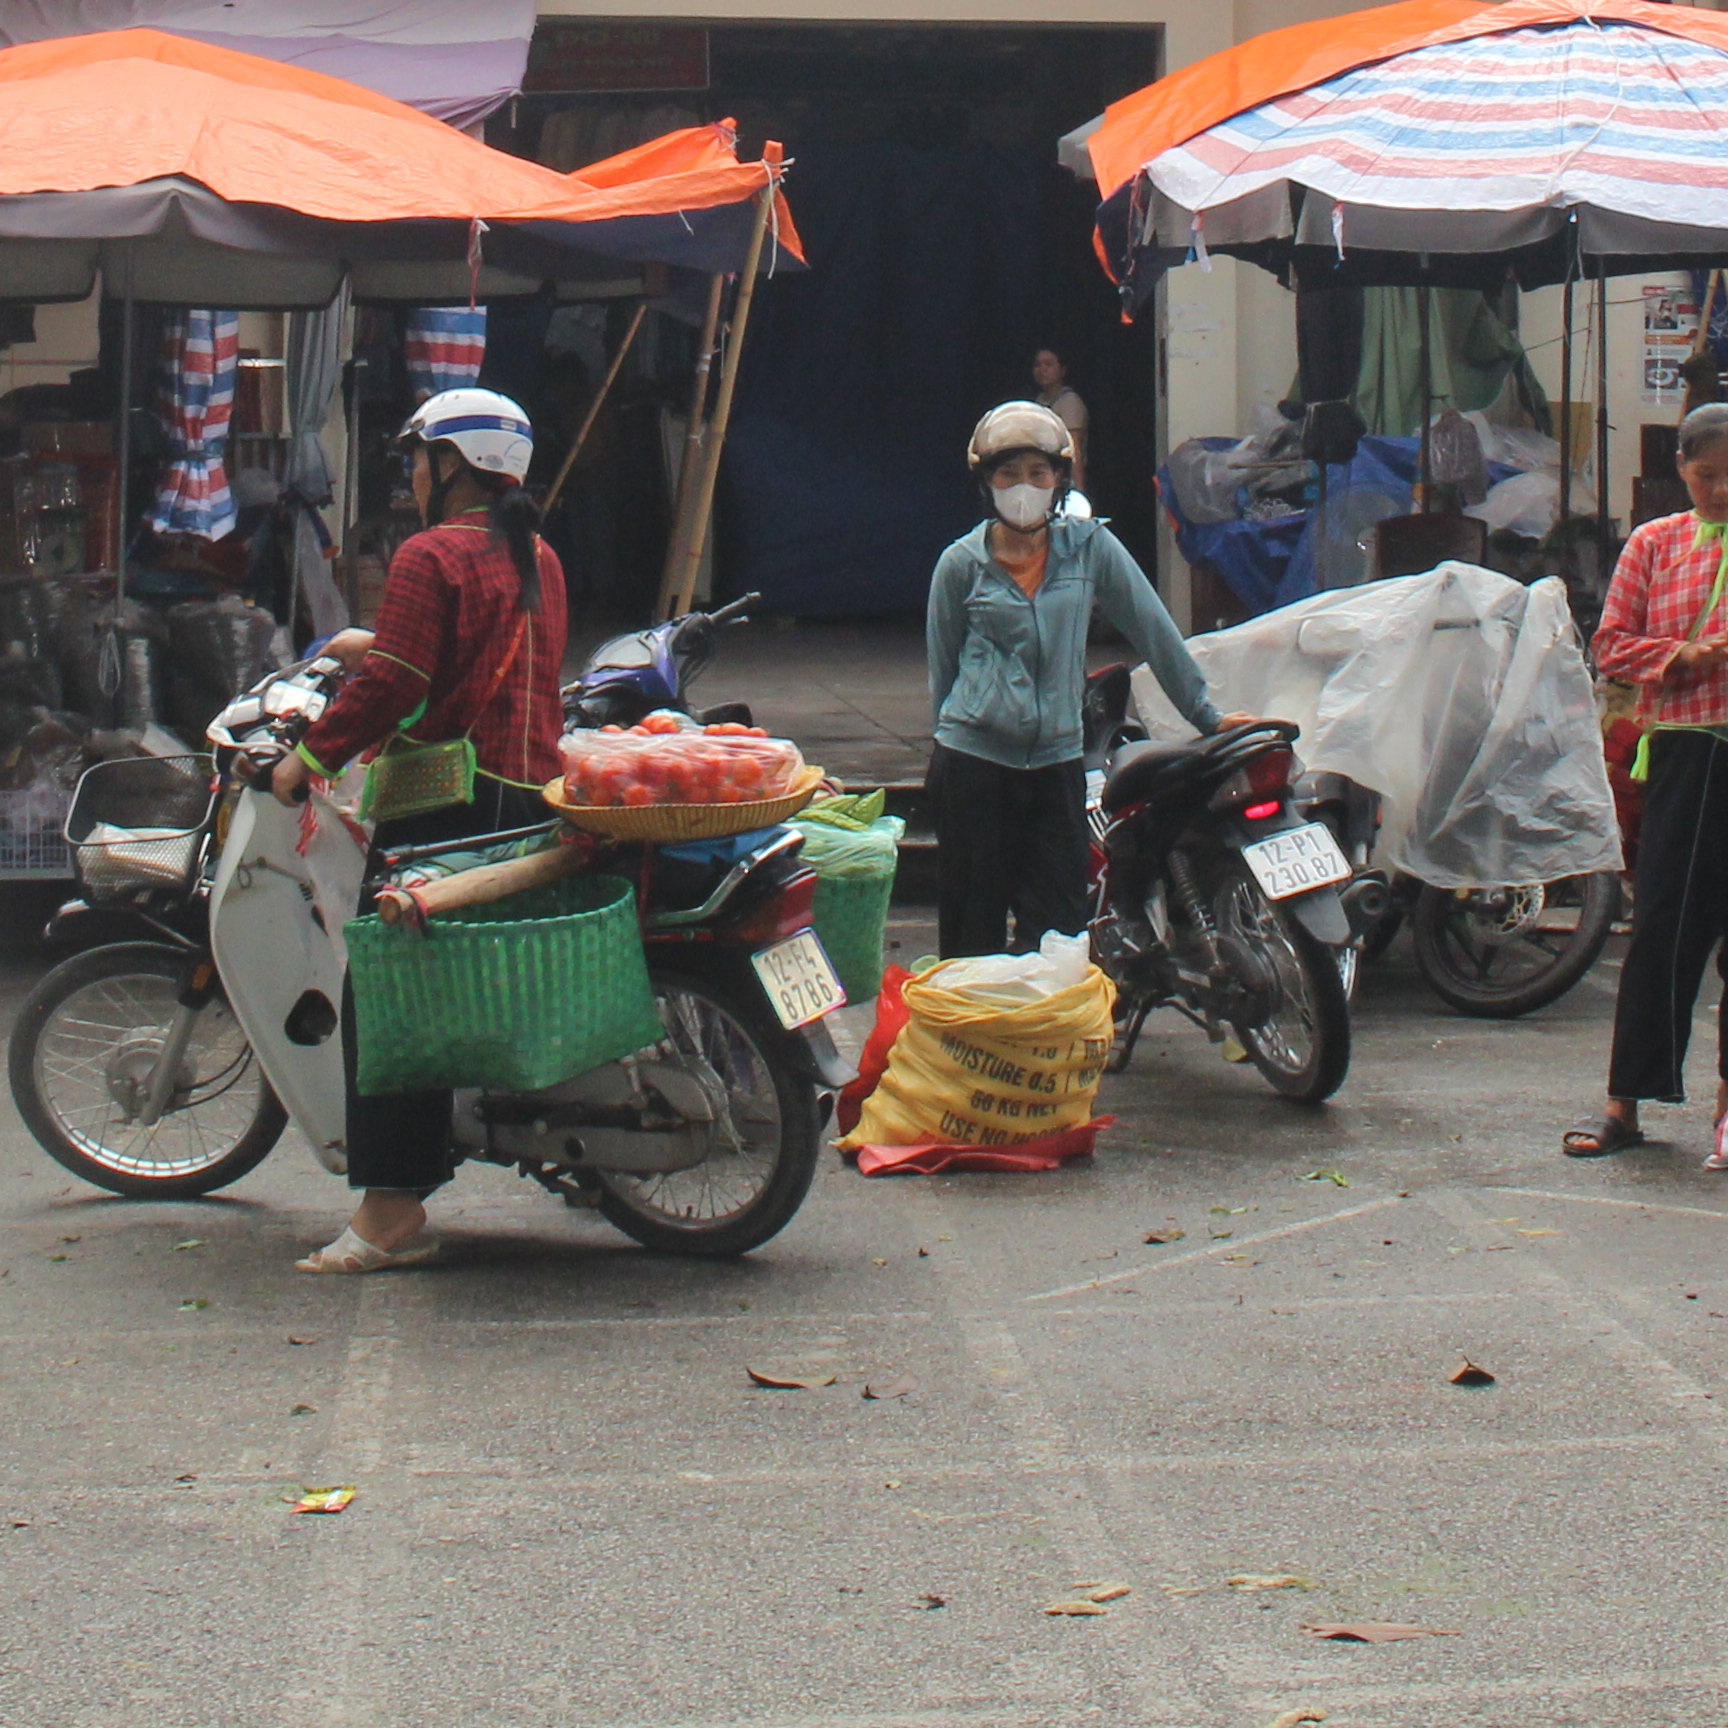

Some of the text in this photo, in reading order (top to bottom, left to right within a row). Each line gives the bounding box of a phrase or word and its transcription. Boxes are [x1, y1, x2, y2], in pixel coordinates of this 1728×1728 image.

[1258, 830, 1321, 866] 12-P1
[1264, 852, 1338, 894] 230.87
[763, 939, 817, 985] 12-F4
[780, 972, 833, 1020] 8786
[941, 1032, 1026, 1087] MOISTURE
[939, 1110, 973, 1141] USE
